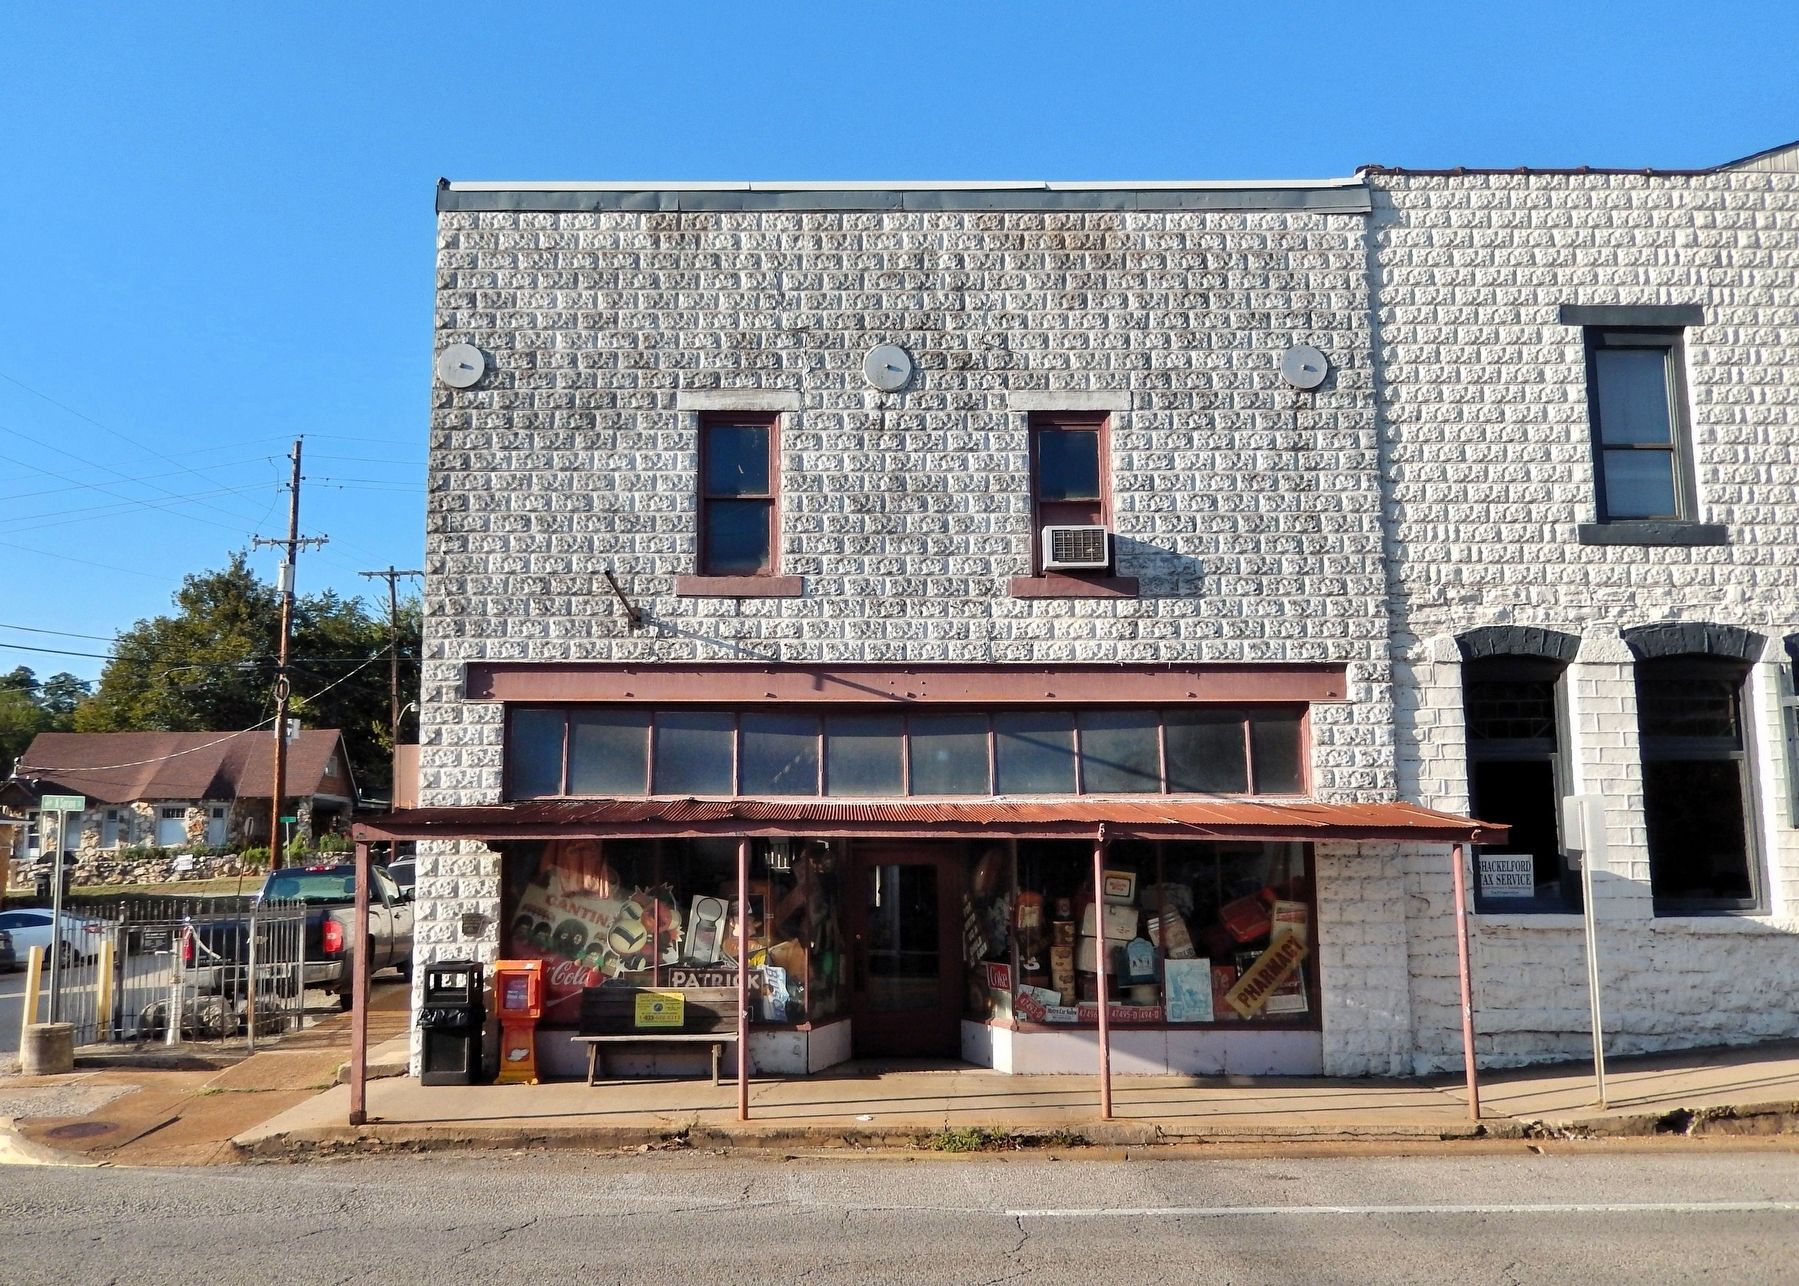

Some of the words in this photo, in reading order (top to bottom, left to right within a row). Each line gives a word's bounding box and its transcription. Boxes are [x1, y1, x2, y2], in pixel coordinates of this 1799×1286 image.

[1496, 873, 1531, 886] SERVICE
[545, 894, 613, 930] CANTIN
[990, 966, 1008, 988] Coke
[1237, 935, 1303, 1009] PHARMACY
